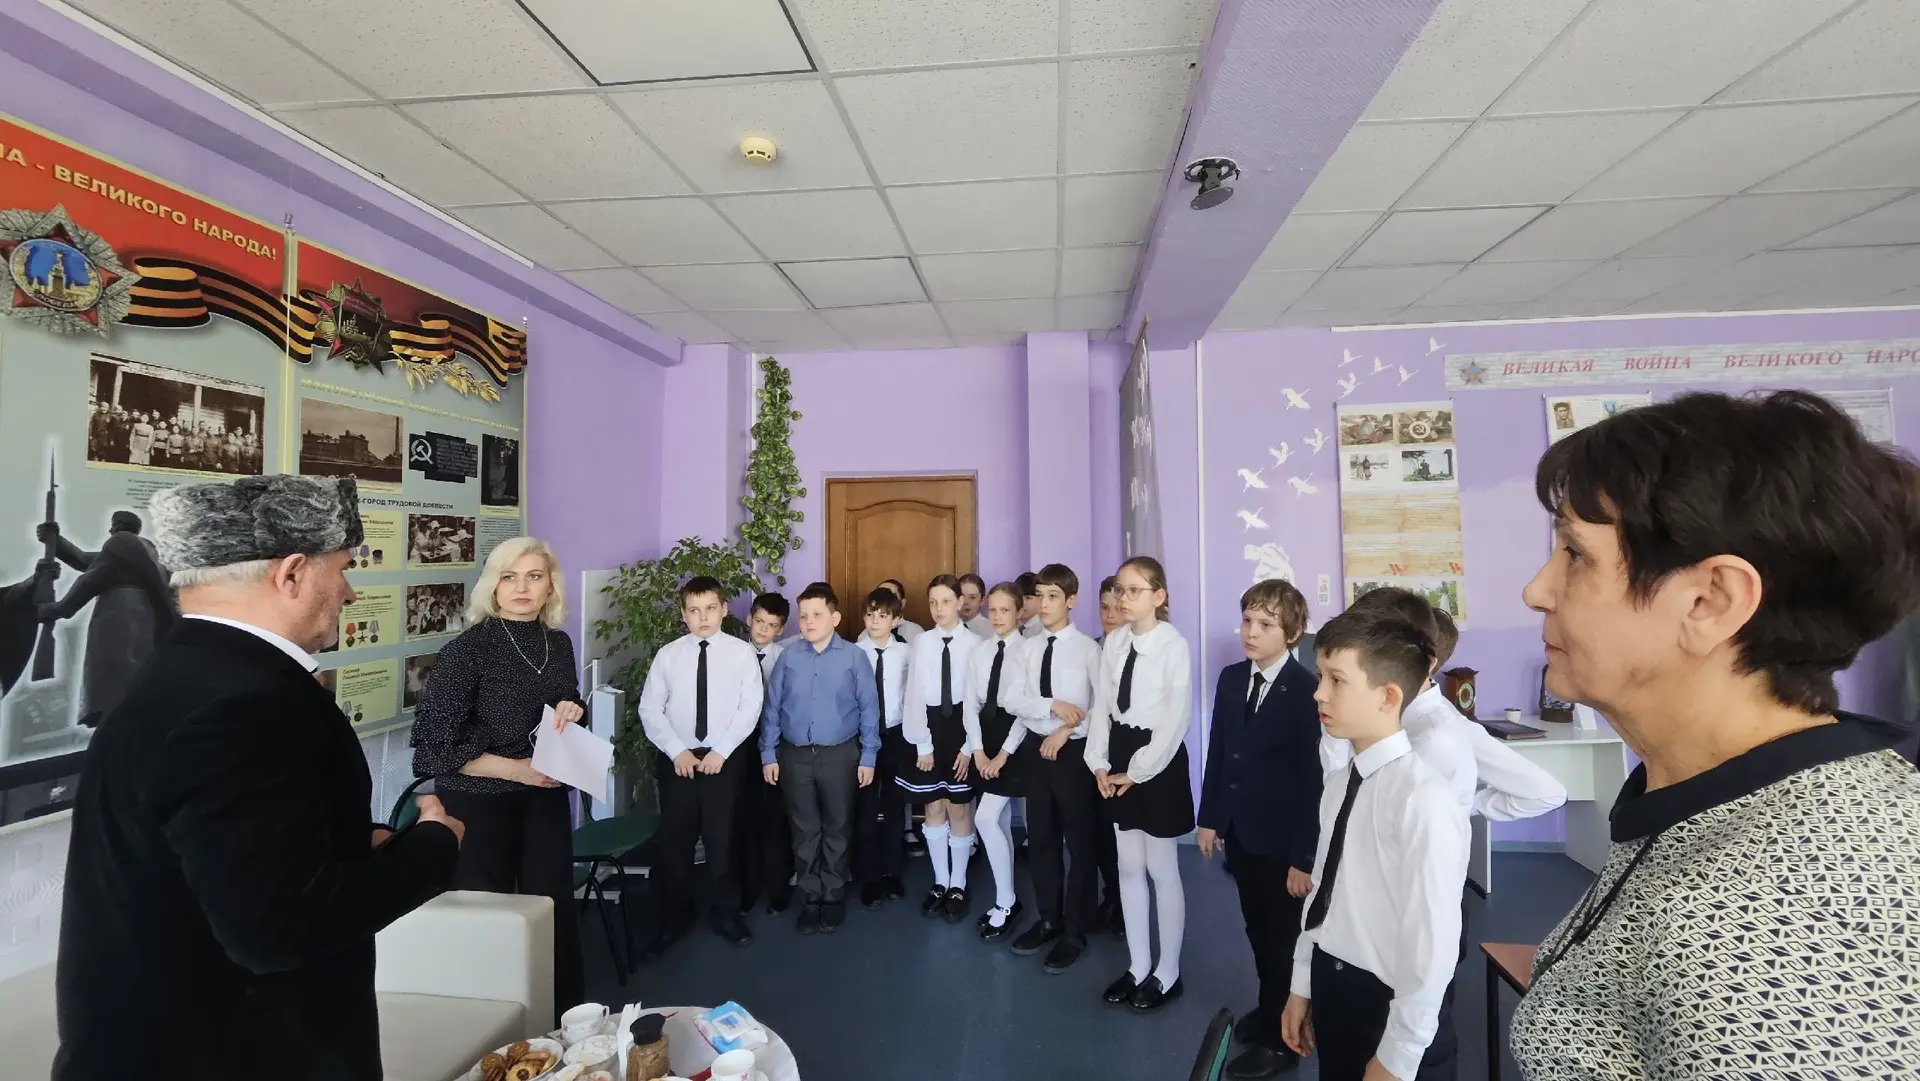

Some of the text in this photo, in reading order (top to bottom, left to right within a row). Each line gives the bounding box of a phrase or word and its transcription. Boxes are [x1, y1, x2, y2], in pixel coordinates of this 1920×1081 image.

[0, 142, 27, 167] А
[53, 164, 188, 225] ВЕЛИКОГО
[192, 217, 277, 261] НАРОДА!
[1502, 358, 1595, 376] ВЕЛИКАЯ
[1623, 352, 1692, 371] ВОЙНА
[1723, 350, 1844, 369] ВЕЛИКОГО
[387, 499, 421, 508] ТРУДОВОЙ
